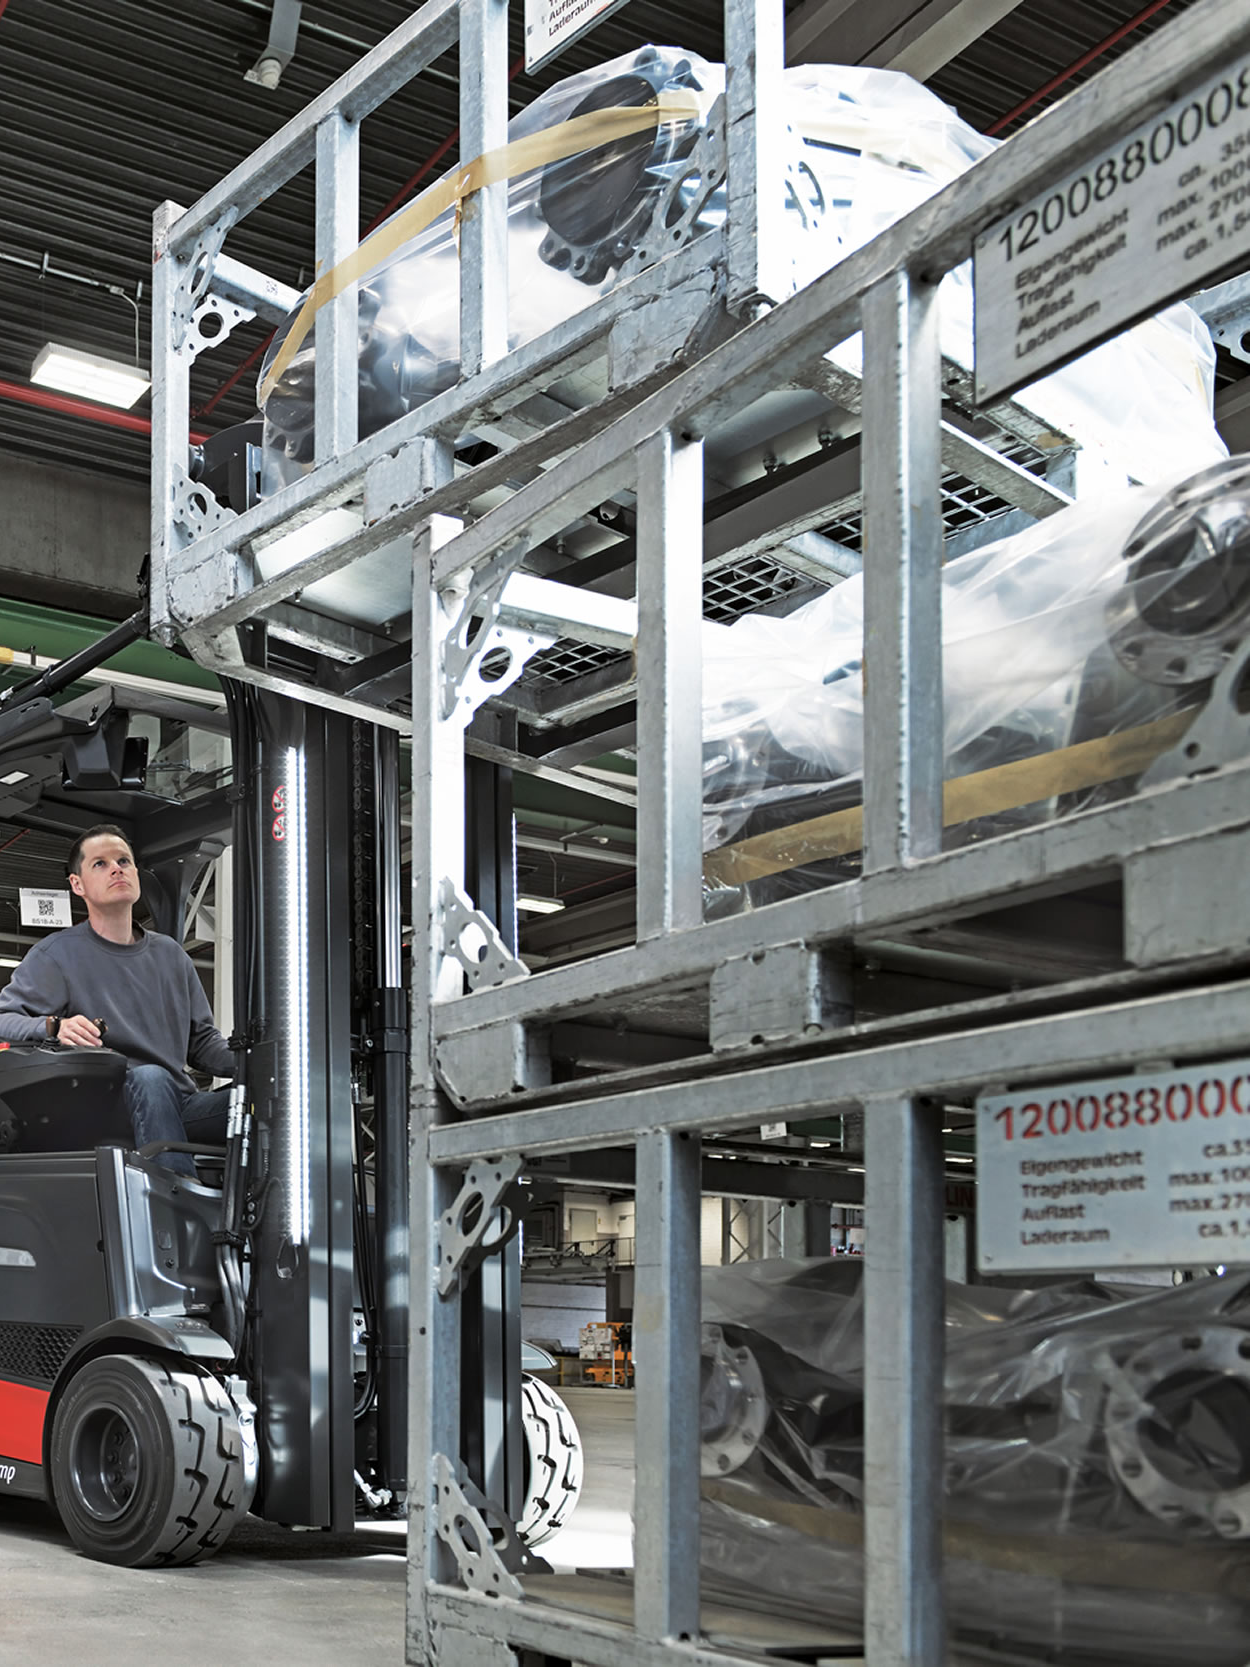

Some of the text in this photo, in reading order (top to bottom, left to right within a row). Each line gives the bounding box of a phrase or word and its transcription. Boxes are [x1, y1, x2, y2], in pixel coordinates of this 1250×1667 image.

[1015, 208, 1129, 290] Eigengewicht
[1220, 128, 1250, 162] 35
[1016, 233, 1126, 309] Tragfähigkeit
[1209, 155, 1250, 191] 100
[1016, 289, 1074, 337] Auflast
[1209, 180, 1250, 220] 270
[1016, 300, 1101, 360] Laderaum
[1020, 1150, 1144, 1177] Eigengewicht
[1021, 1175, 1146, 1200] Tragfähigkeit
[1022, 1204, 1086, 1221] Auflast
[1020, 1228, 1110, 1245] Laderaum
